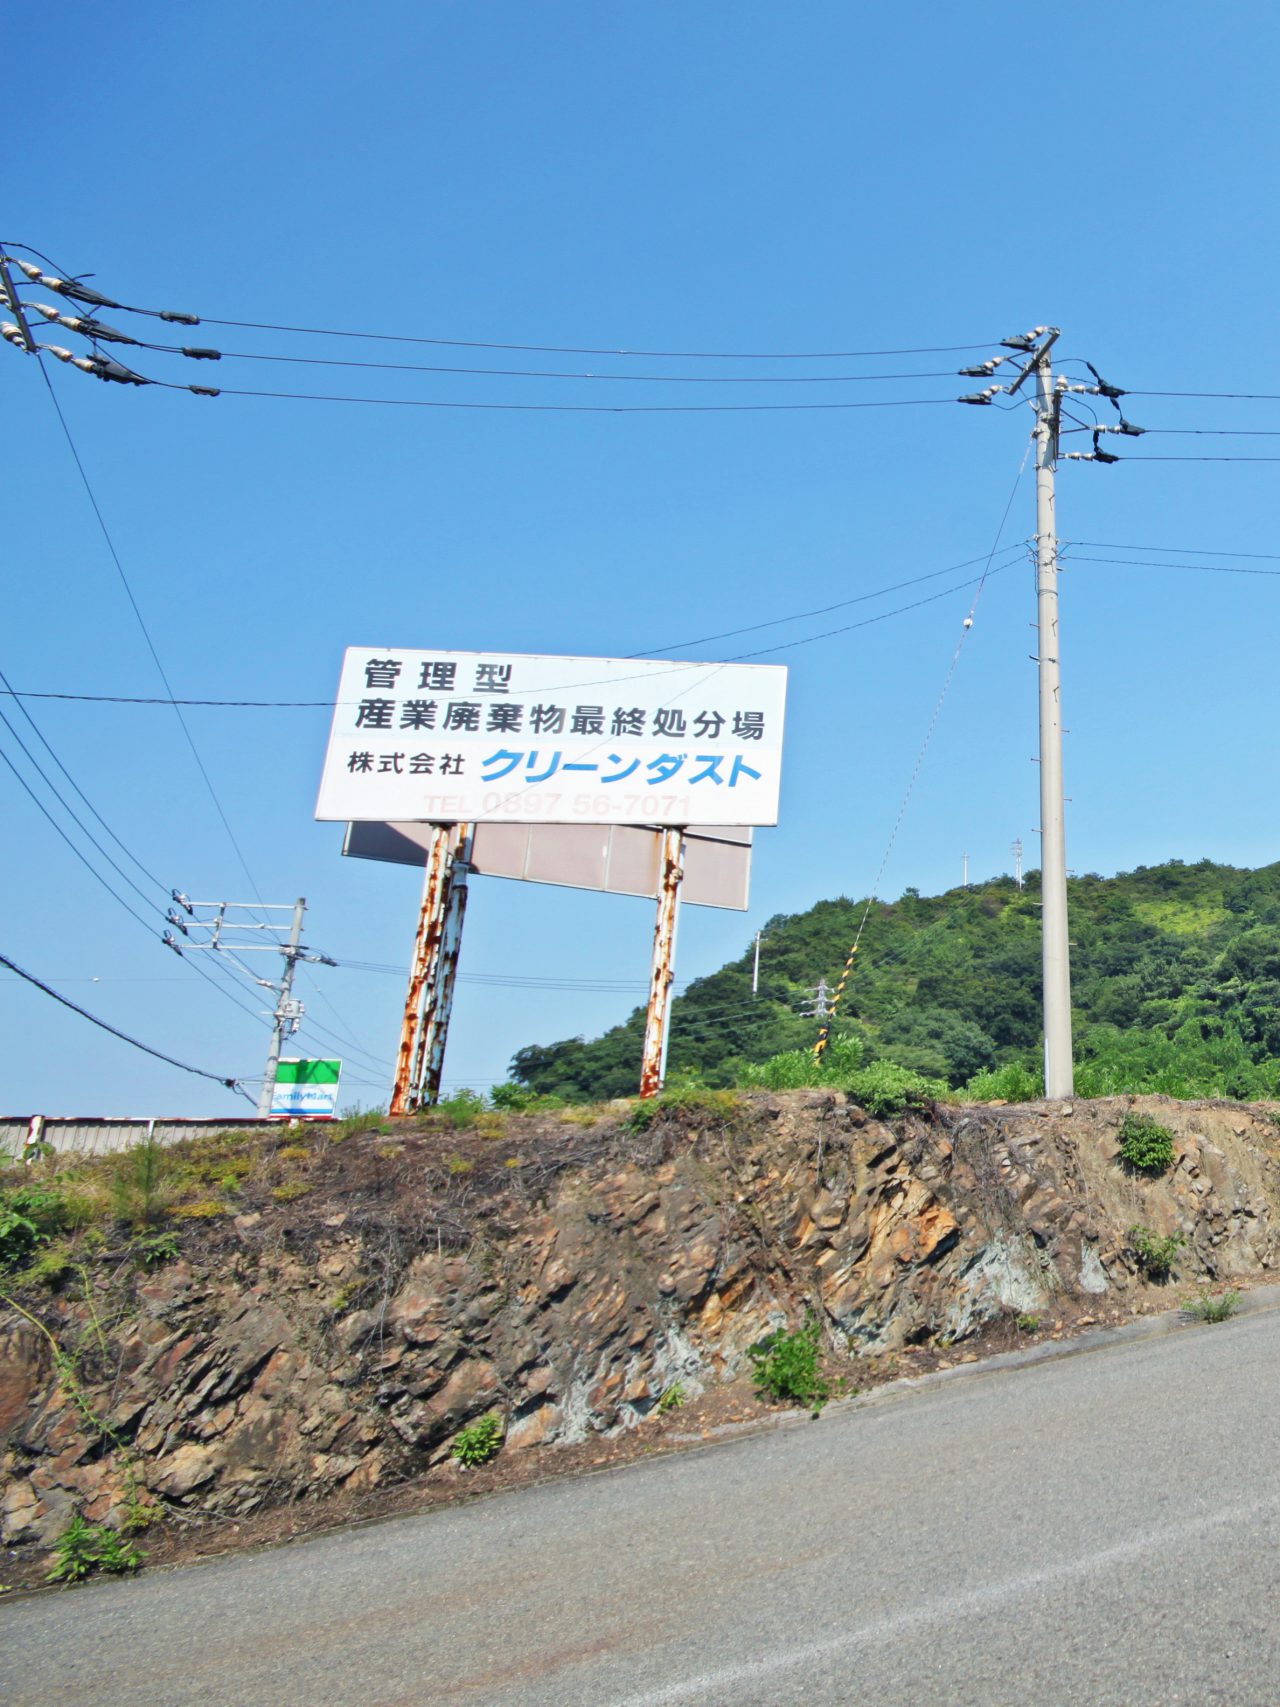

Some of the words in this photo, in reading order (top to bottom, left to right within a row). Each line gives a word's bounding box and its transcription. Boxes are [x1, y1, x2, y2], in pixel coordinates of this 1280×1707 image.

[364, 658, 513, 694] 管理型
[355, 698, 765, 740] 産業廃棄物最終処分場
[347, 751, 466, 775] 株式会社
[480, 749, 762, 788] クリーンダスト
[424, 795, 473, 814] TEL
[482, 792, 563, 815] 0897
[572, 793, 692, 818] 56-7071
